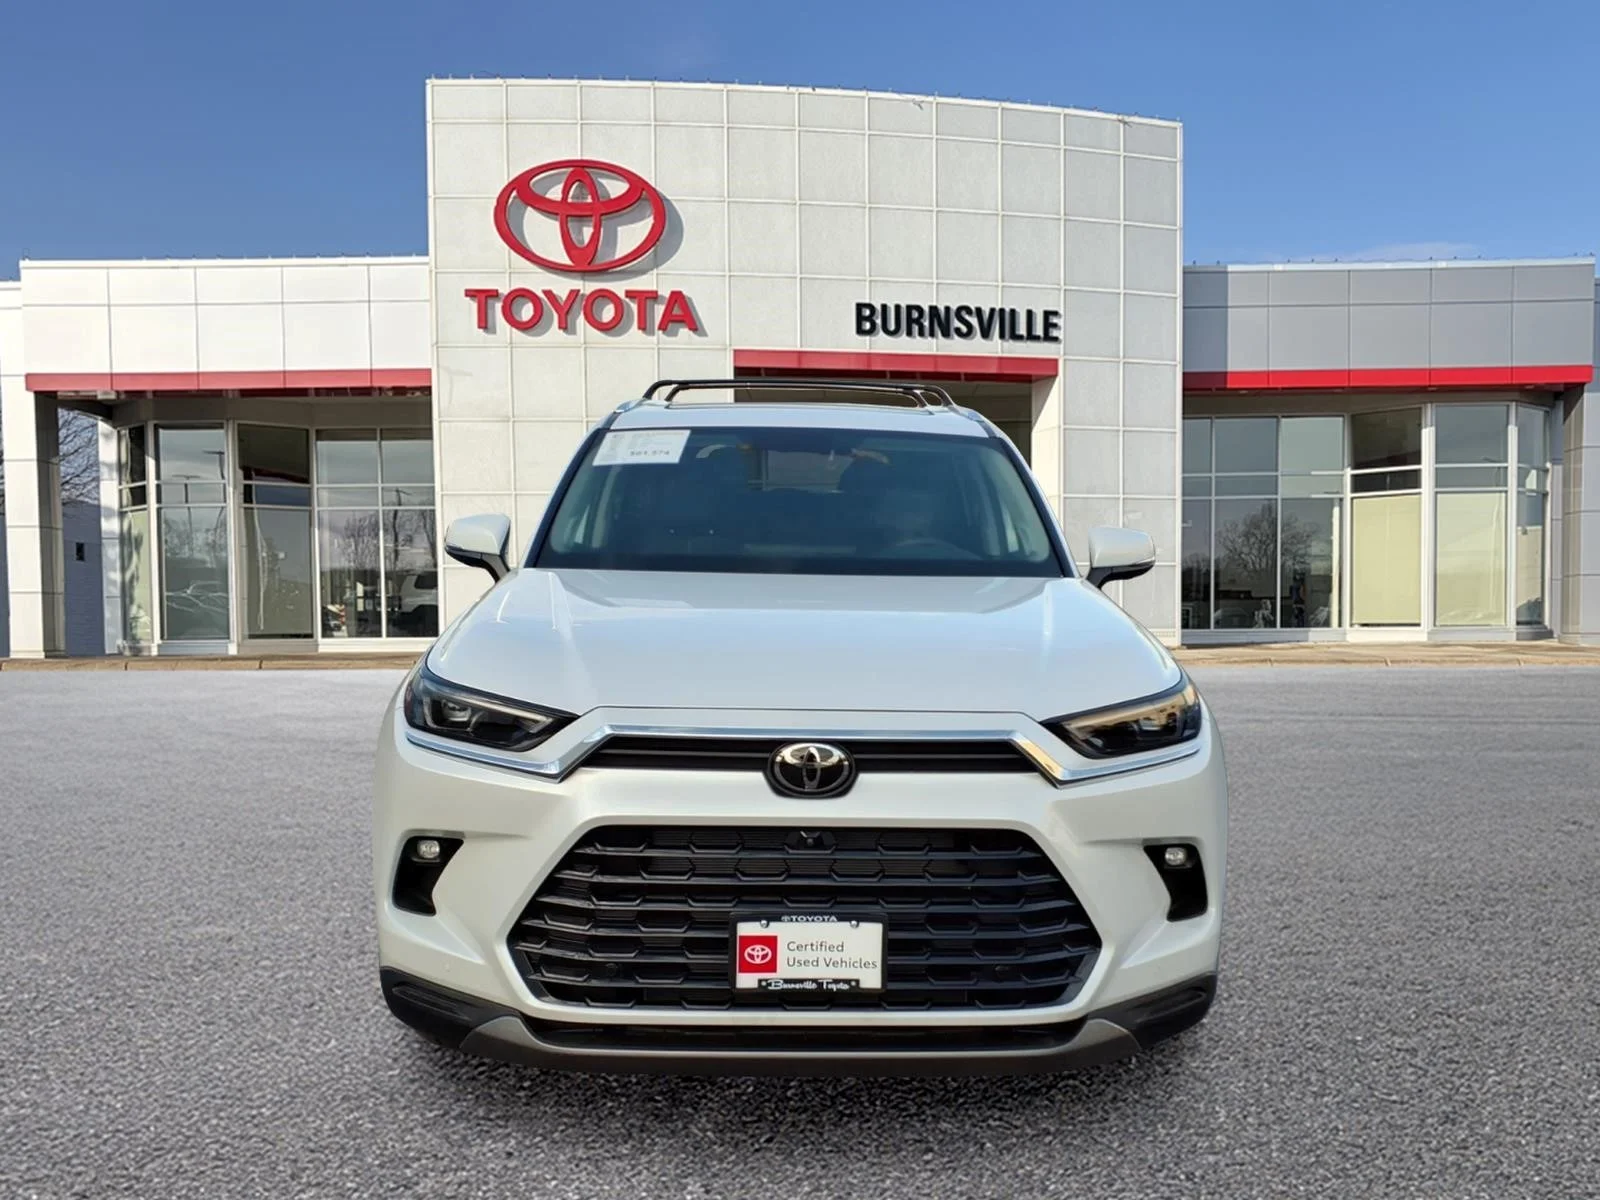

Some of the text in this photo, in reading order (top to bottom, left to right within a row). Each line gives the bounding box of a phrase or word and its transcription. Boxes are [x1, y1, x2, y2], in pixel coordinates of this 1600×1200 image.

[464, 287, 699, 332] TOYOTA
[855, 302, 1060, 342] BURNSVILLE
[786, 940, 845, 953] Certified
[786, 956, 878, 969] Used Vehicles
